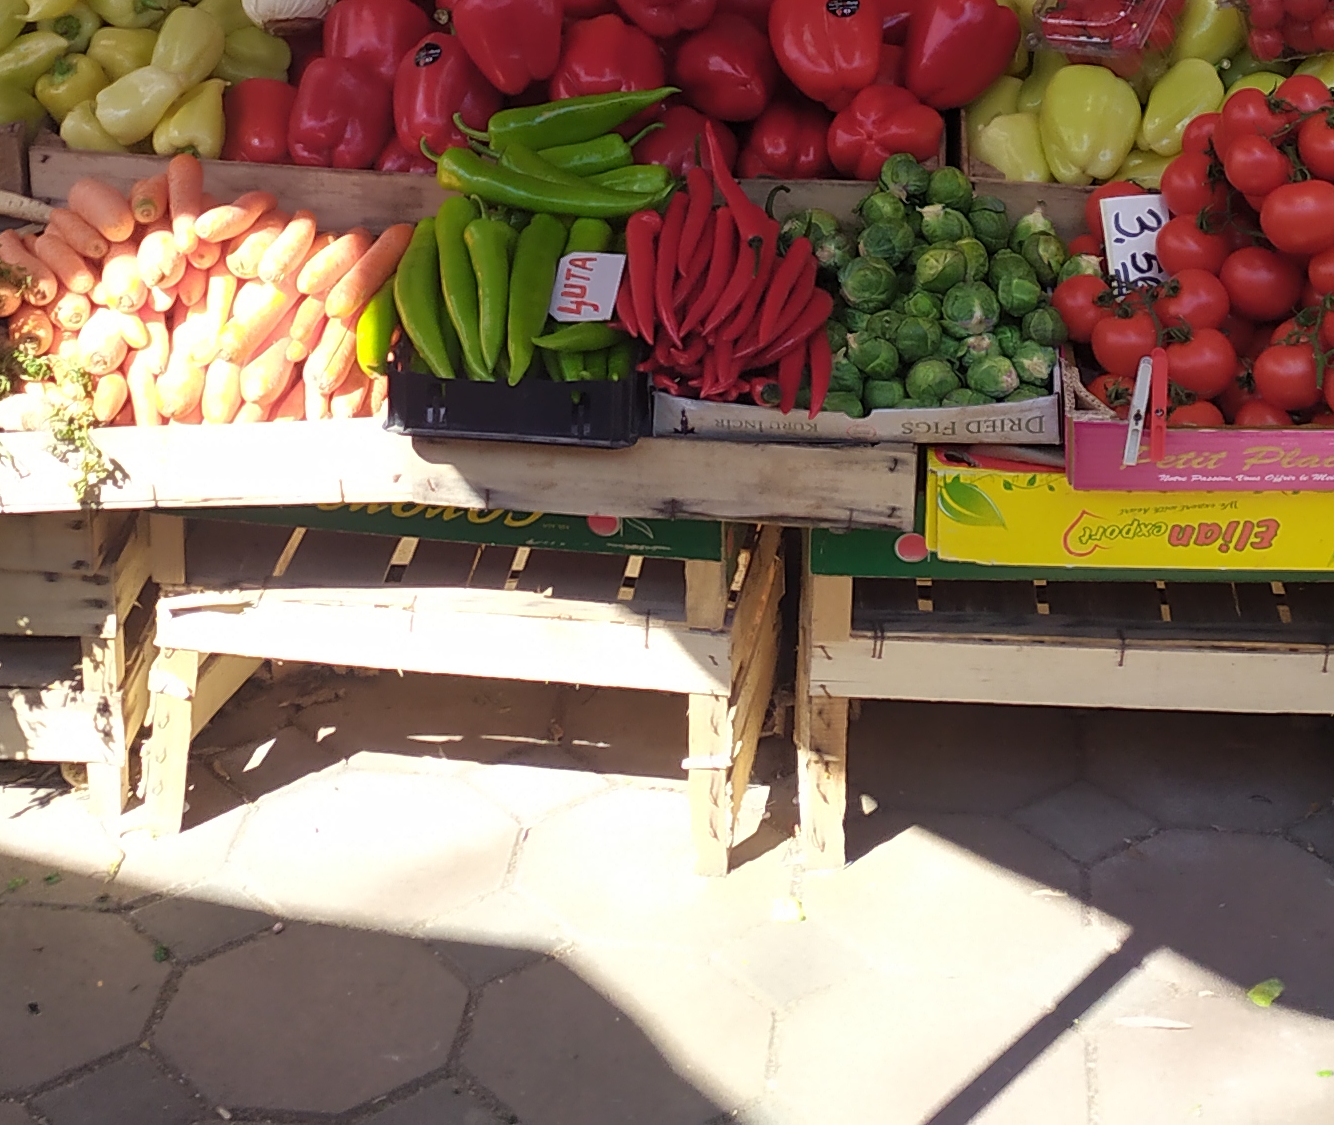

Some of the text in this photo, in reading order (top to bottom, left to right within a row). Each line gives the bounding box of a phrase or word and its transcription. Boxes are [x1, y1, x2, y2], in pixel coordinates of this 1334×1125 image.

[900, 415, 1045, 436] DRIED FIGS
[1080, 517, 1279, 551] Elian export
